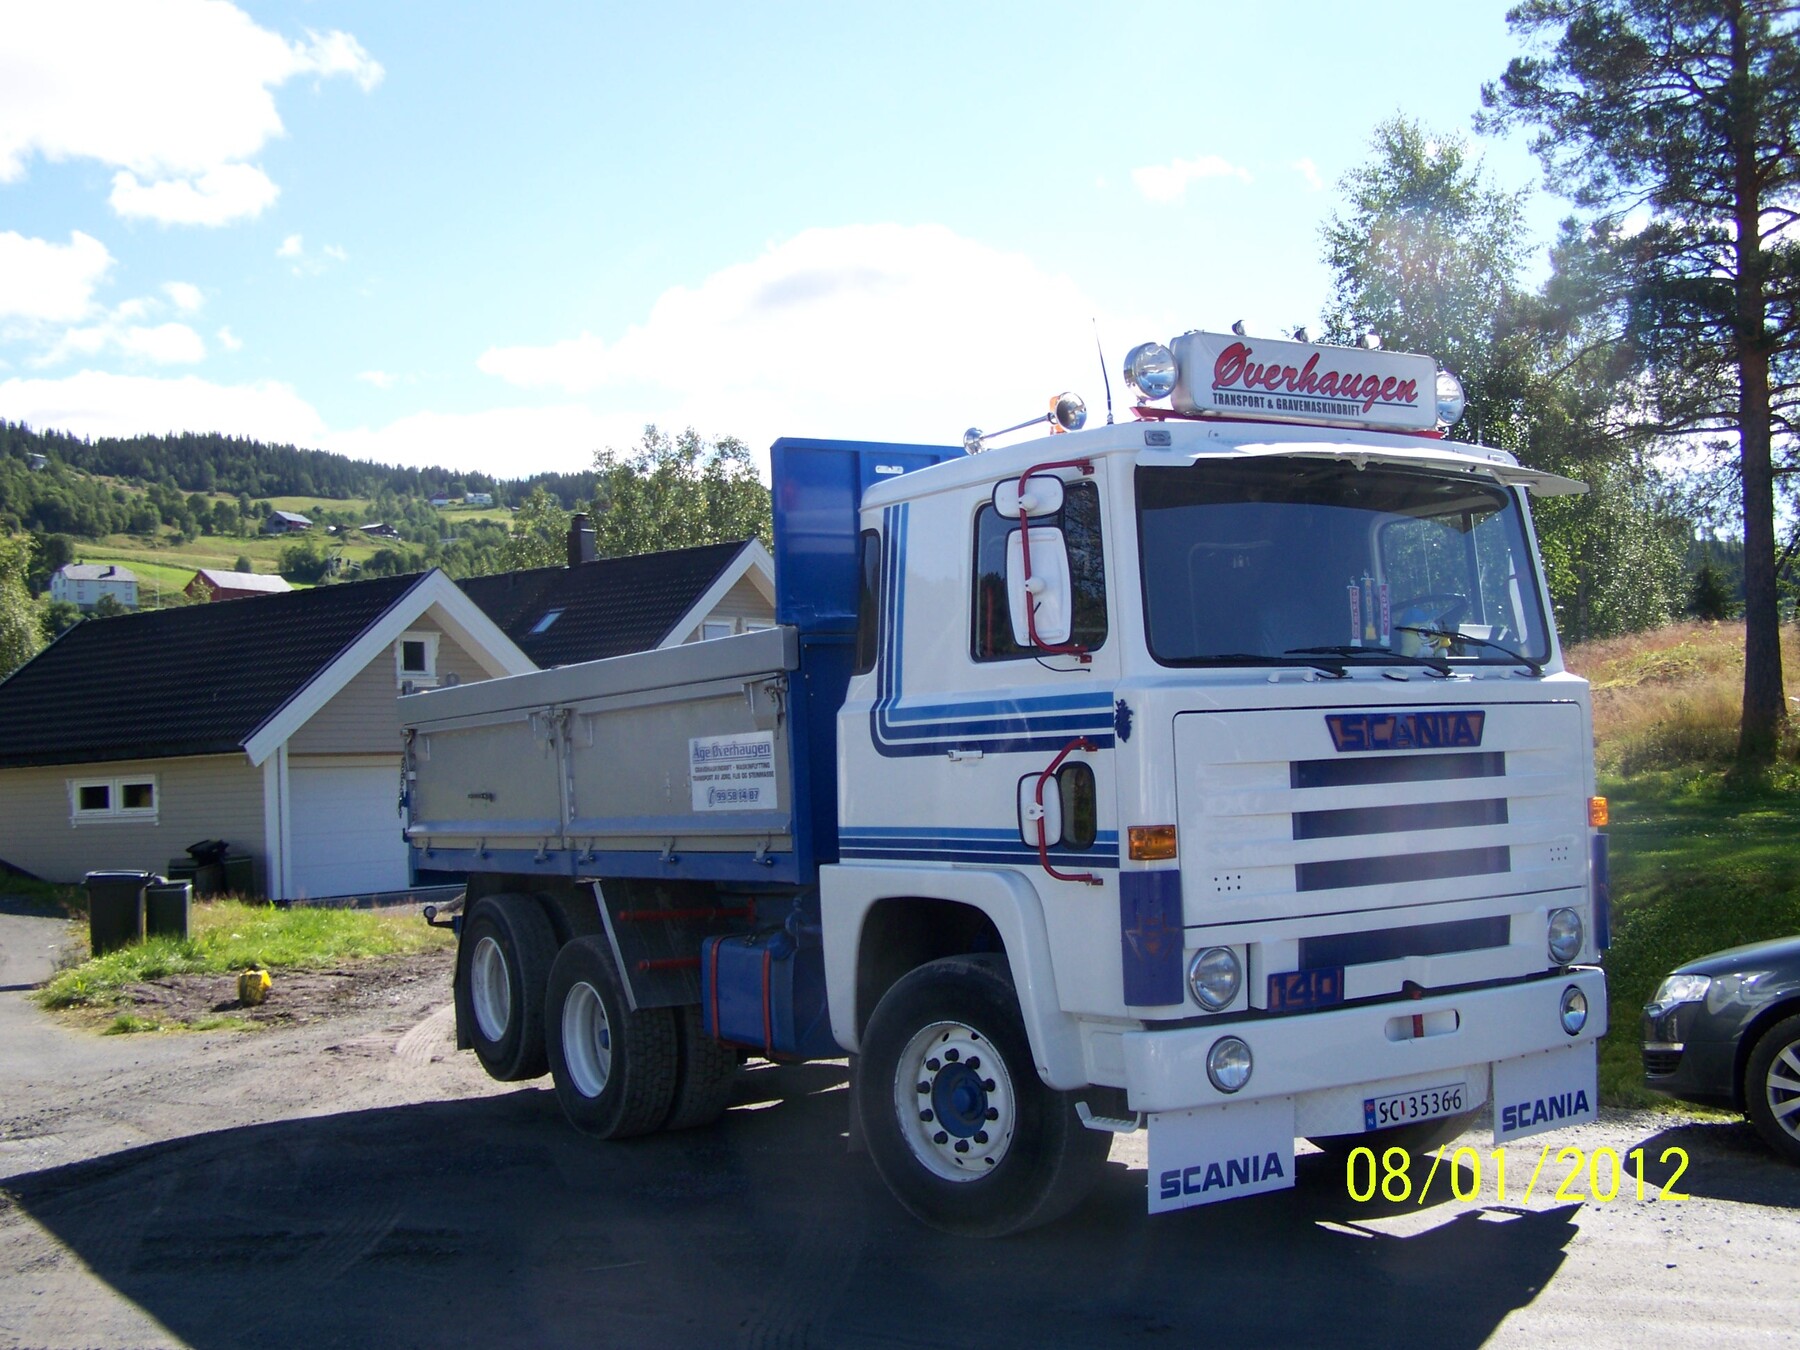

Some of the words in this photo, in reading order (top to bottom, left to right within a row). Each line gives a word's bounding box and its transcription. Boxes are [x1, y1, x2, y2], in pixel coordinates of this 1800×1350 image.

[1212, 341, 1418, 413] Øverhaugen
[1212, 392, 1265, 408] TRANSPORT
[1267, 398, 1274, 409] &
[1276, 397, 1360, 416] GRAVEMASKINDRIFT
[1339, 713, 1477, 750] SCANIA
[693, 740, 711, 761] Åge
[712, 741, 771, 758] Øverhaugen
[716, 791, 726, 801] 99
[727, 790, 737, 801] 58
[1274, 970, 1338, 1010] 140
[1409, 1089, 1462, 1118] 35366
[1502, 1089, 1589, 1132] SCANIA
[1160, 1152, 1284, 1200] SCANIA
